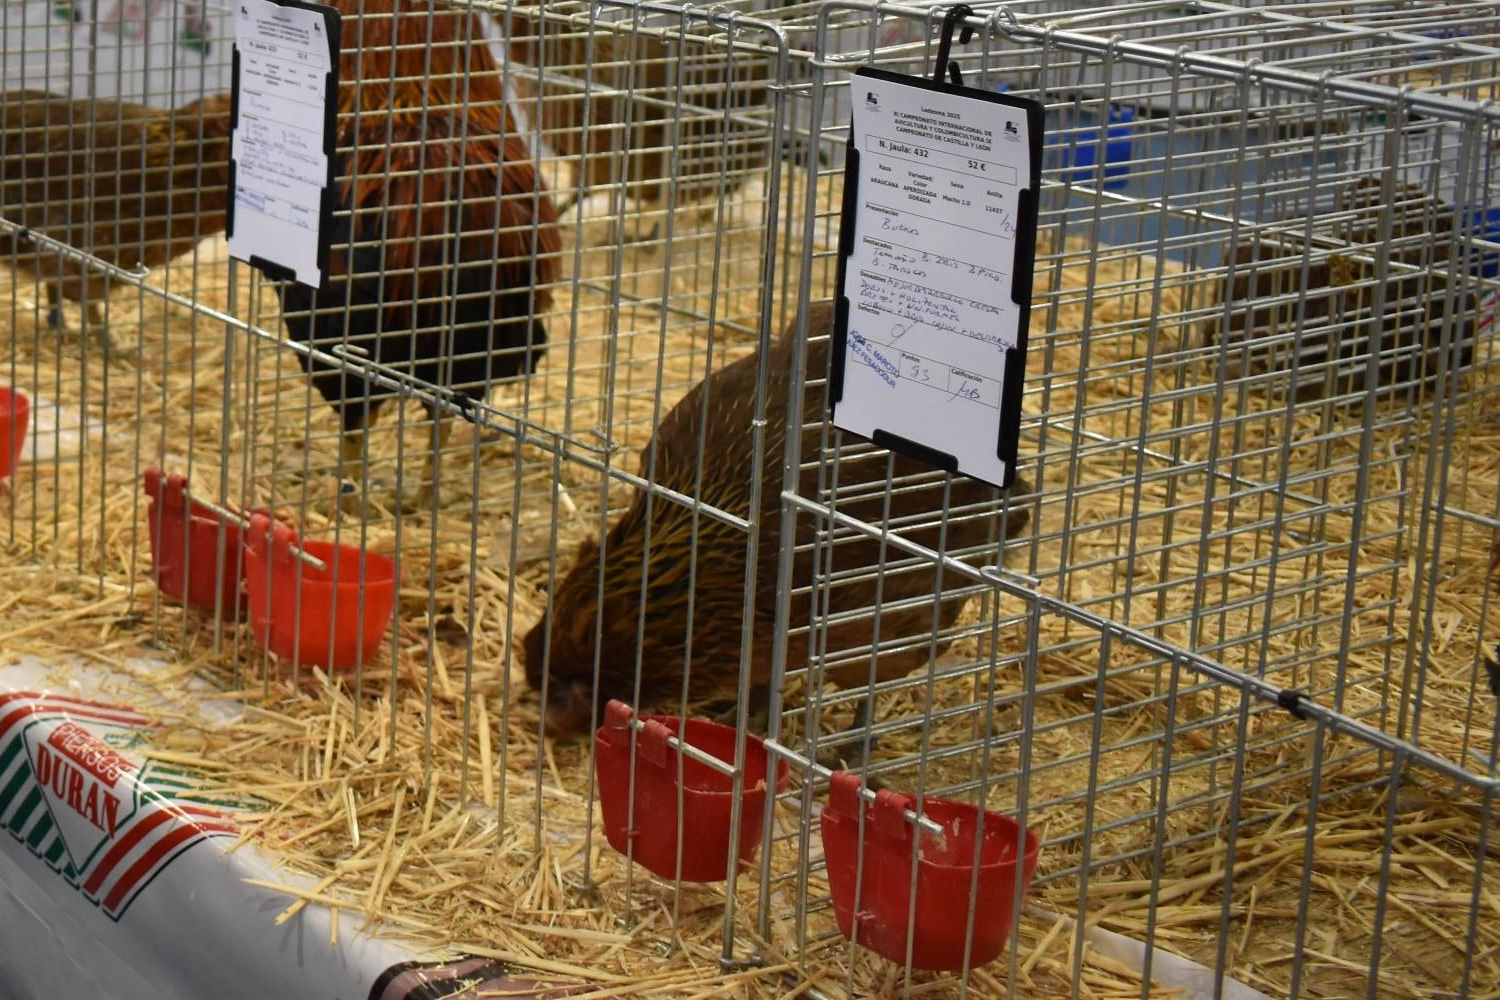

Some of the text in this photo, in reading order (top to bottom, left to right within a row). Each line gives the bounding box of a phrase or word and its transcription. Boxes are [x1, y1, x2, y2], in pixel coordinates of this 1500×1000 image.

[879, 140, 928, 158] N. Jaula: 432
[967, 160, 985, 171] 52 €
[51, 722, 126, 781] PIENSOS
[36, 742, 121, 840] DURAN
